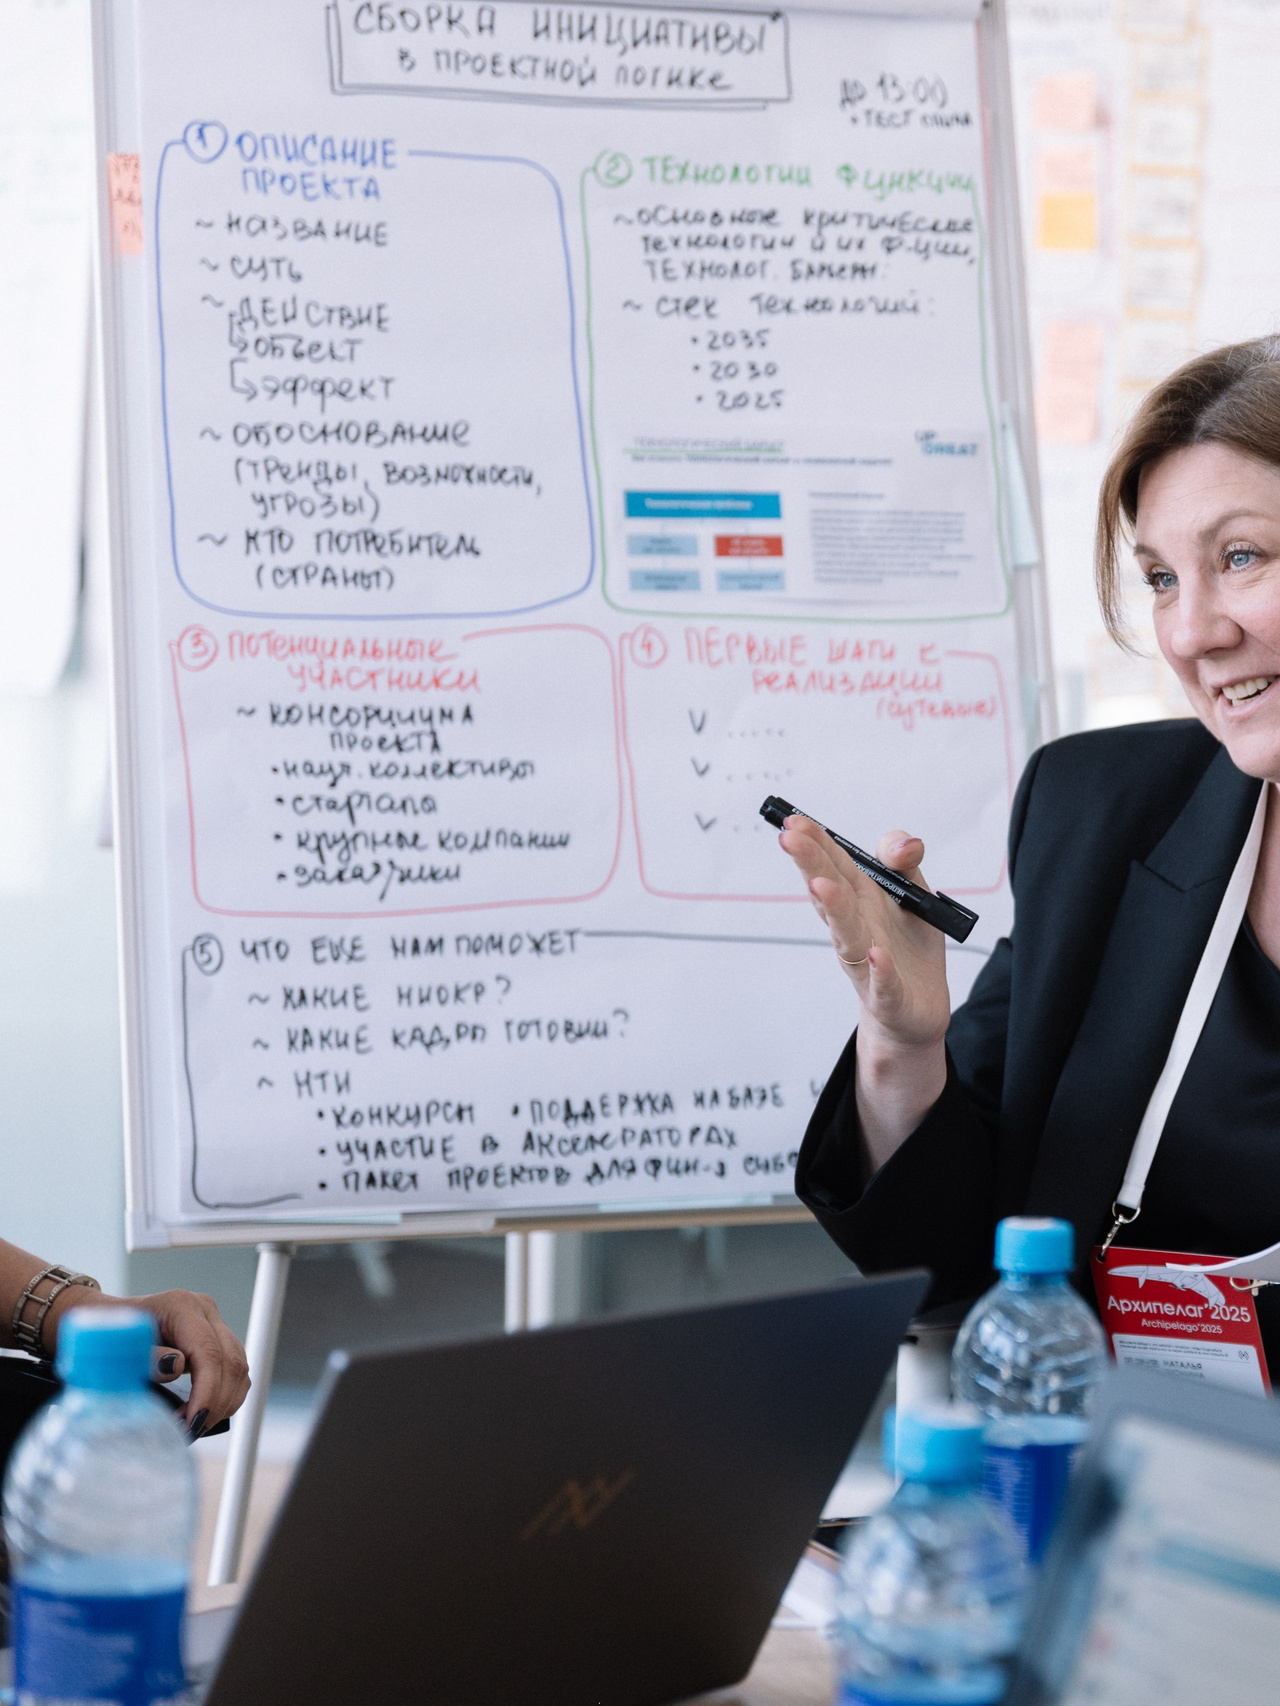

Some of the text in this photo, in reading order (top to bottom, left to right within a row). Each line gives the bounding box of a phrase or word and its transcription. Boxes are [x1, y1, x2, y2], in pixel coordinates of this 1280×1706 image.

[354, 5, 767, 57] СБОРКА ИНИЦИАТИВЫ
[435, 50, 597, 88] ПРОЕКТНОЙ
[235, 131, 398, 169] ОПИСАНИЕ
[242, 167, 382, 201] ПРОЕКТА
[643, 156, 812, 187] ТЕХНОЛОГИИ
[226, 212, 390, 248] НАЗВАНИЕ
[706, 328, 772, 351] 2035
[710, 361, 778, 381] 2030
[716, 389, 786, 412] 2025
[684, 627, 808, 669] ПЕРВЫЕ
[288, 664, 483, 694] УЧАСТНИКИ
[330, 730, 442, 756] ПРОЕКТА
[240, 937, 290, 963] ЧТО
[391, 935, 445, 960] НАМ
[455, 928, 581, 956] ПОМОЖЕТ
[282, 984, 372, 1012] КАКИЕ
[287, 1023, 374, 1055] КАКИЕ
[293, 1069, 352, 1099] НТИ
[530, 1092, 675, 1126] ПОДДЕРЖКА
[336, 1135, 456, 1165] УЧАСТИЕ
[342, 1168, 420, 1193] ПАКЕТ
[447, 1163, 571, 1191] ПРОЕКТОВ
